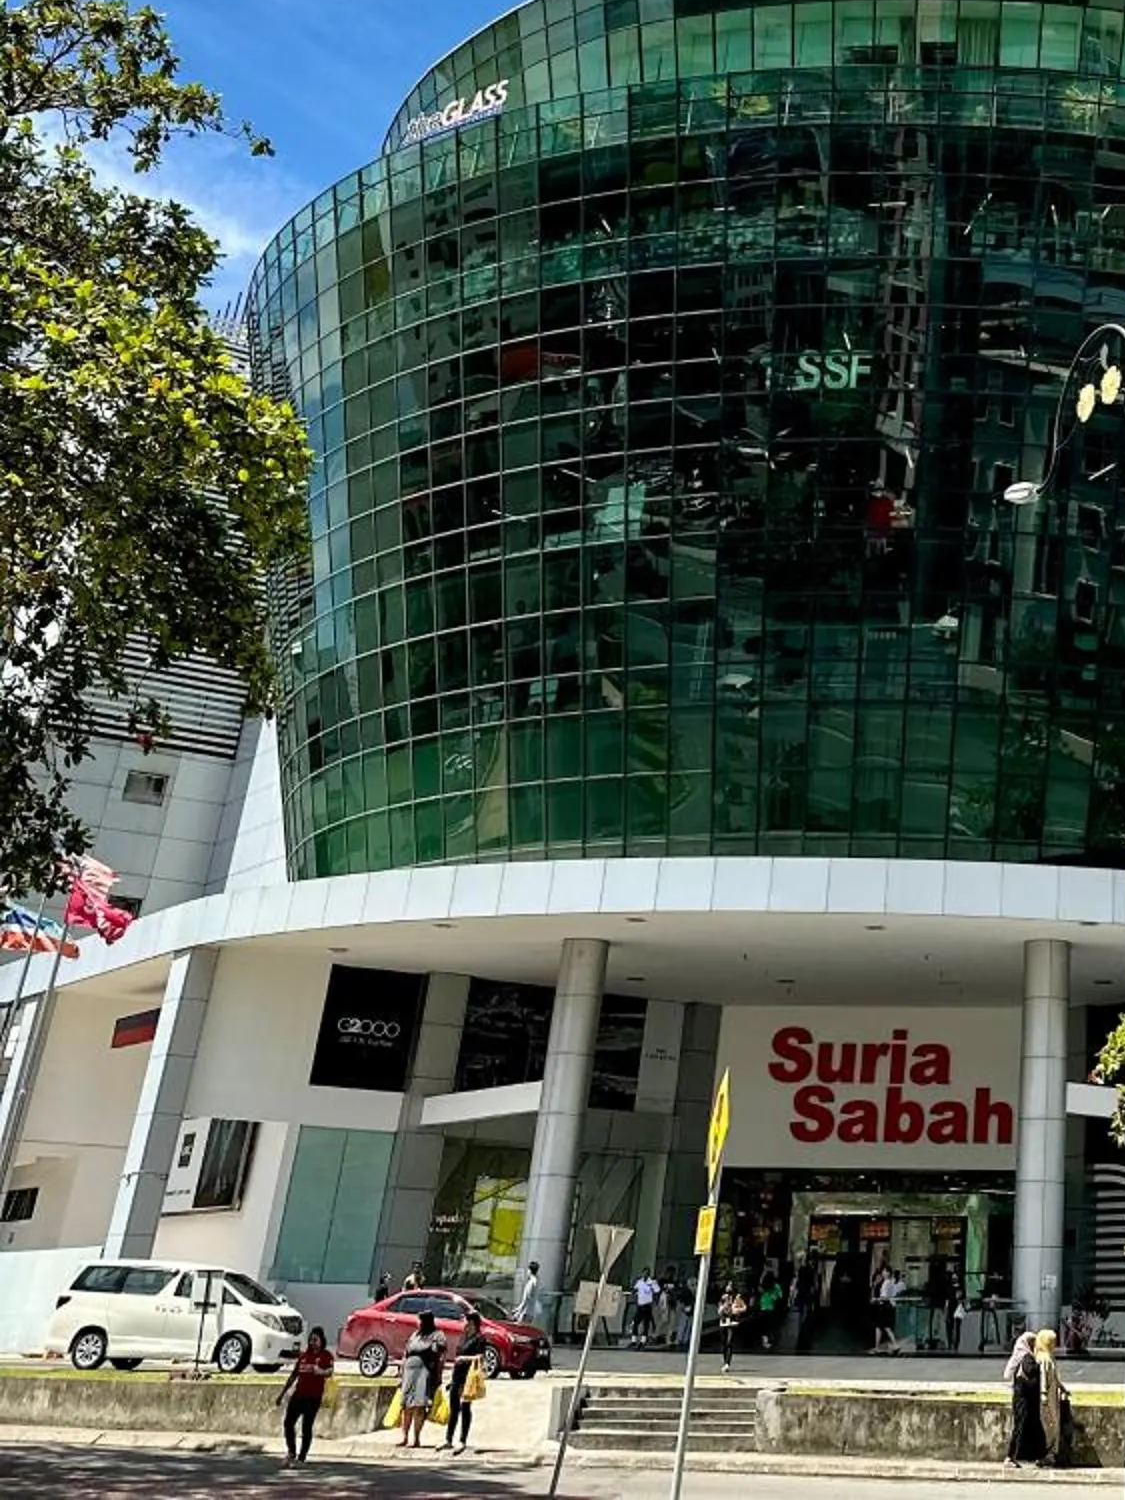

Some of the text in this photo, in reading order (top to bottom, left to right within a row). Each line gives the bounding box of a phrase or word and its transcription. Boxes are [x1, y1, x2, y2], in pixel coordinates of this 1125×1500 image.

[796, 349, 873, 389] SSF
[337, 1017, 401, 1038] G2000
[768, 1026, 951, 1085] Suria
[789, 1085, 1013, 1144] Sabah
